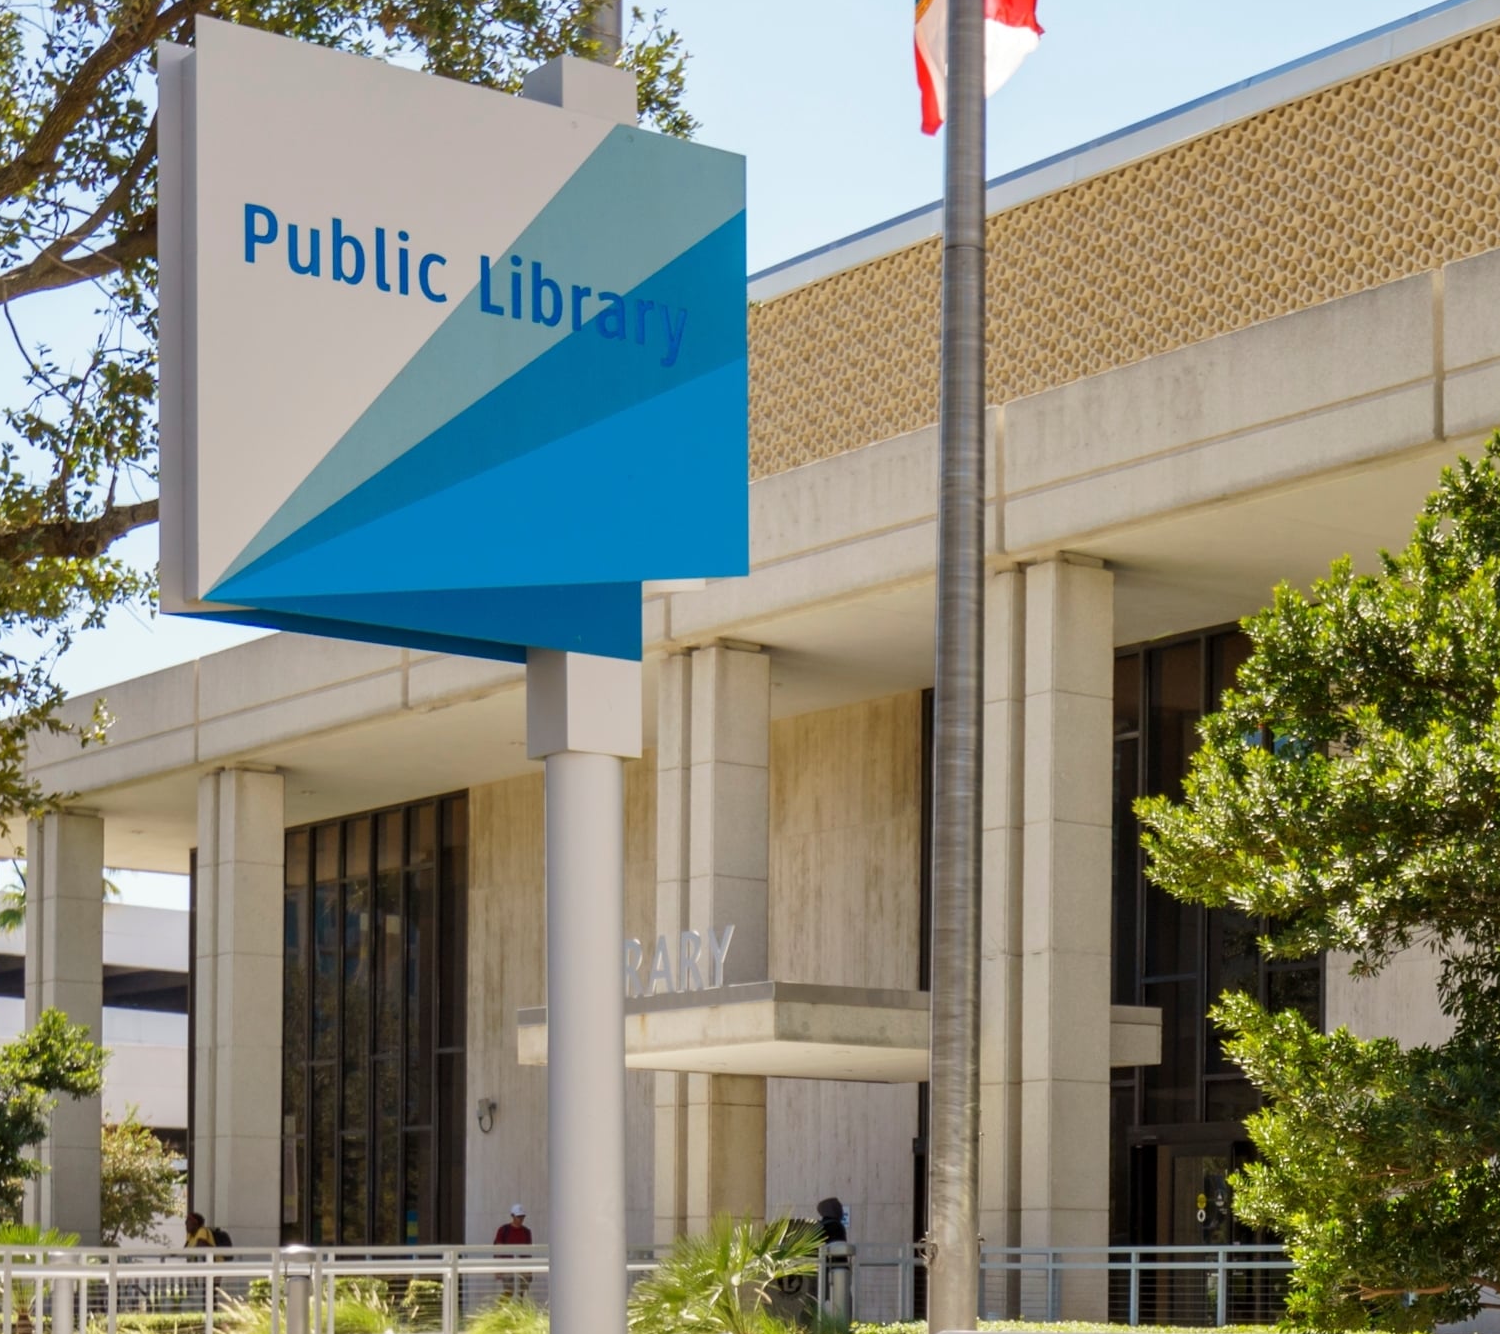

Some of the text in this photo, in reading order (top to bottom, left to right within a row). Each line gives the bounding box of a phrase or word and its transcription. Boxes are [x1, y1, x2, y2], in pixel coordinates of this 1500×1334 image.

[244, 202, 689, 368] Public Library
[624, 924, 736, 999] RARY
